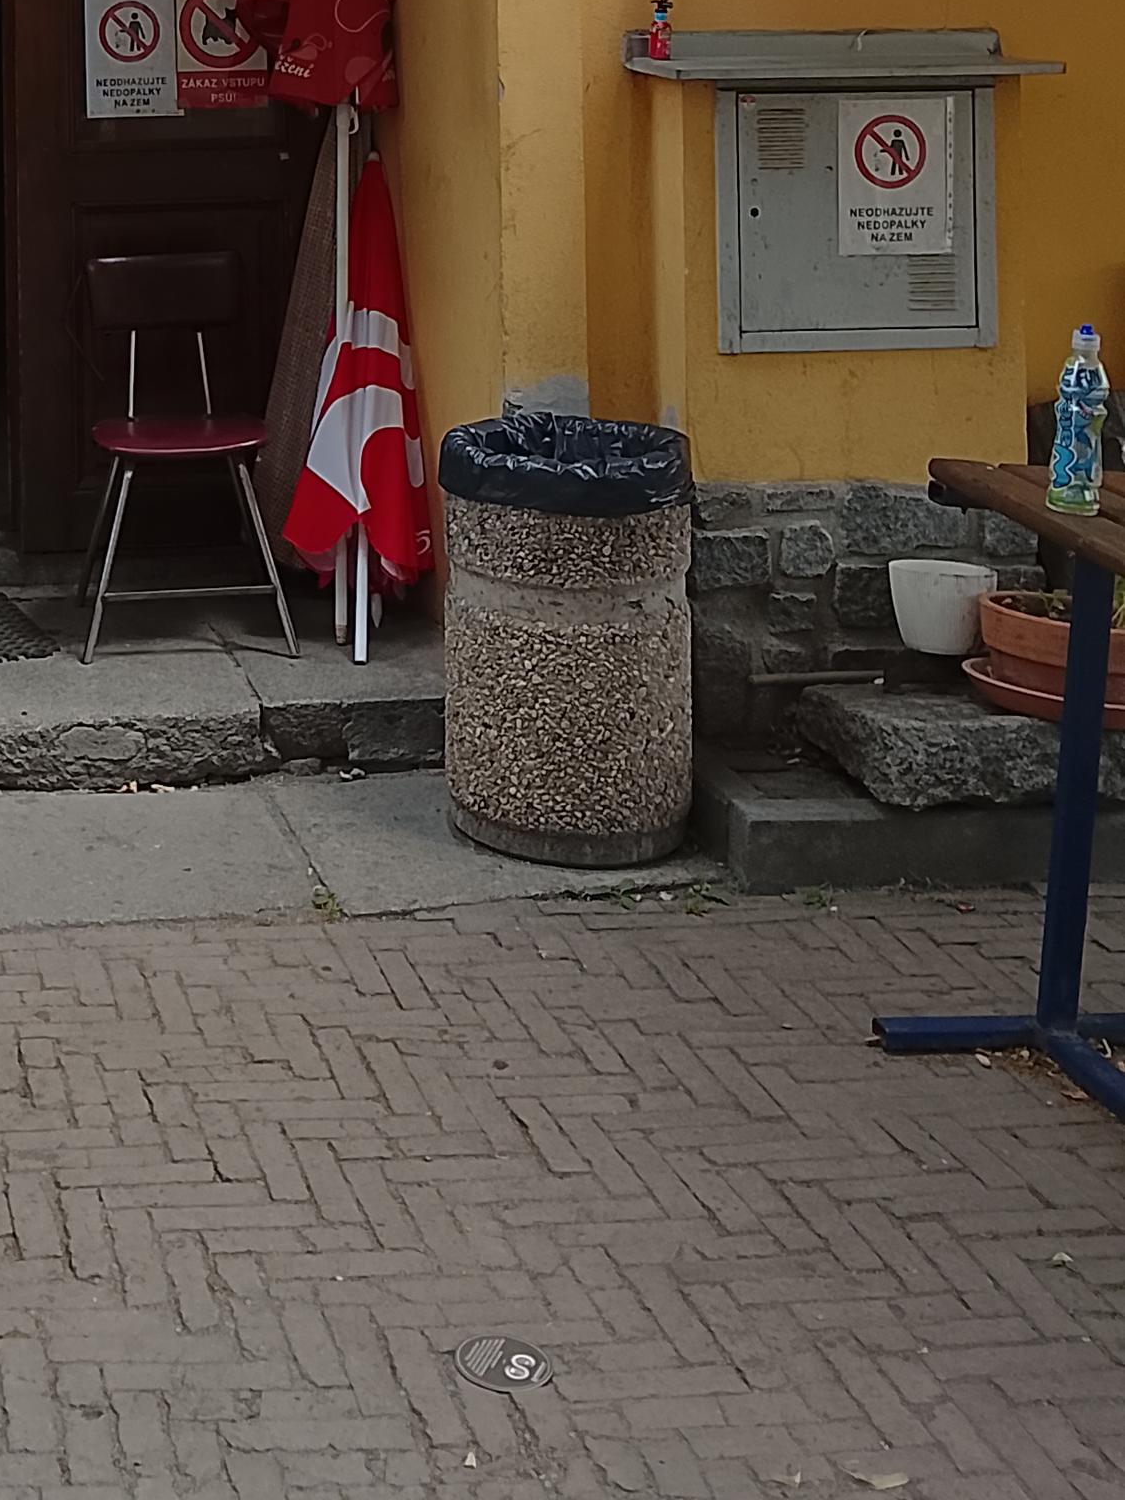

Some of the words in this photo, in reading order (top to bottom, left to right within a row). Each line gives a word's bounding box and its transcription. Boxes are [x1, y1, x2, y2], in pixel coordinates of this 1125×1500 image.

[95, 76, 168, 87] NEODHAZUJTE
[181, 77, 218, 88] ZÁKAZ
[221, 76, 265, 87] VSTUPU
[102, 88, 162, 97] NEDOPALKY
[114, 99, 128, 108] NA
[130, 98, 150, 107] ZEM
[849, 206, 935, 218] NEODHAZUJTE
[857, 219, 927, 230] NEDOPALKY
[871, 232, 887, 242] NA
[889, 232, 913, 242] ZEM
